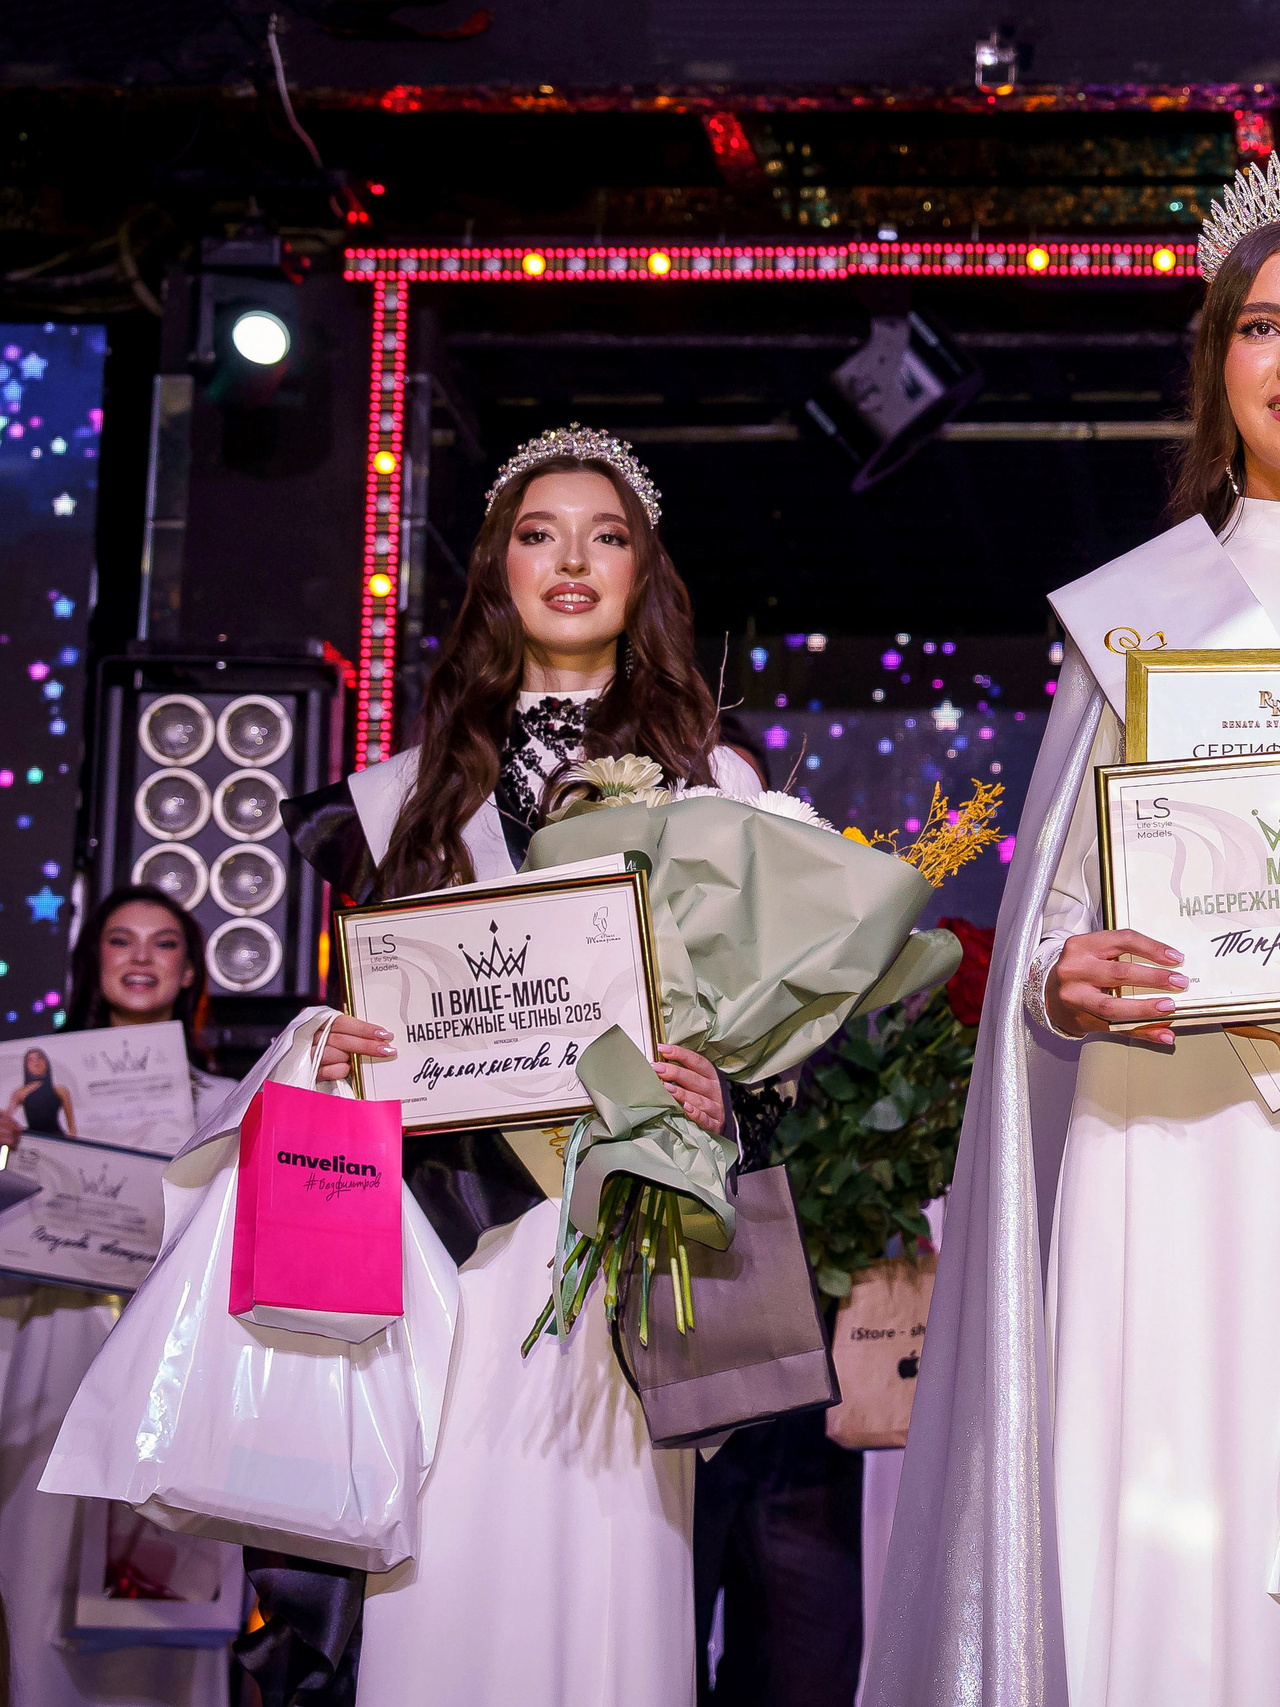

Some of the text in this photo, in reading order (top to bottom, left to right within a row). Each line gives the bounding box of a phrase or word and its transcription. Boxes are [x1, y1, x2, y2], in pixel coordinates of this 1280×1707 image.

[1222, 720, 1261, 729] RENATA
[1135, 797, 1171, 820] LS
[1137, 829, 1173, 839] Models
[1152, 820, 1173, 829] Style
[368, 933, 397, 955] LS
[371, 963, 399, 973] Models
[431, 976, 571, 1018] II ВИЦЕ-МИСС
[406, 1002, 602, 1043] НАБЕРЕЖНЫЕ ЧЕЛНЫ 2025
[277, 1150, 377, 1177] anvelian
[303, 1172, 382, 1201] #безфильтров
[850, 1326, 896, 1341] iStore
